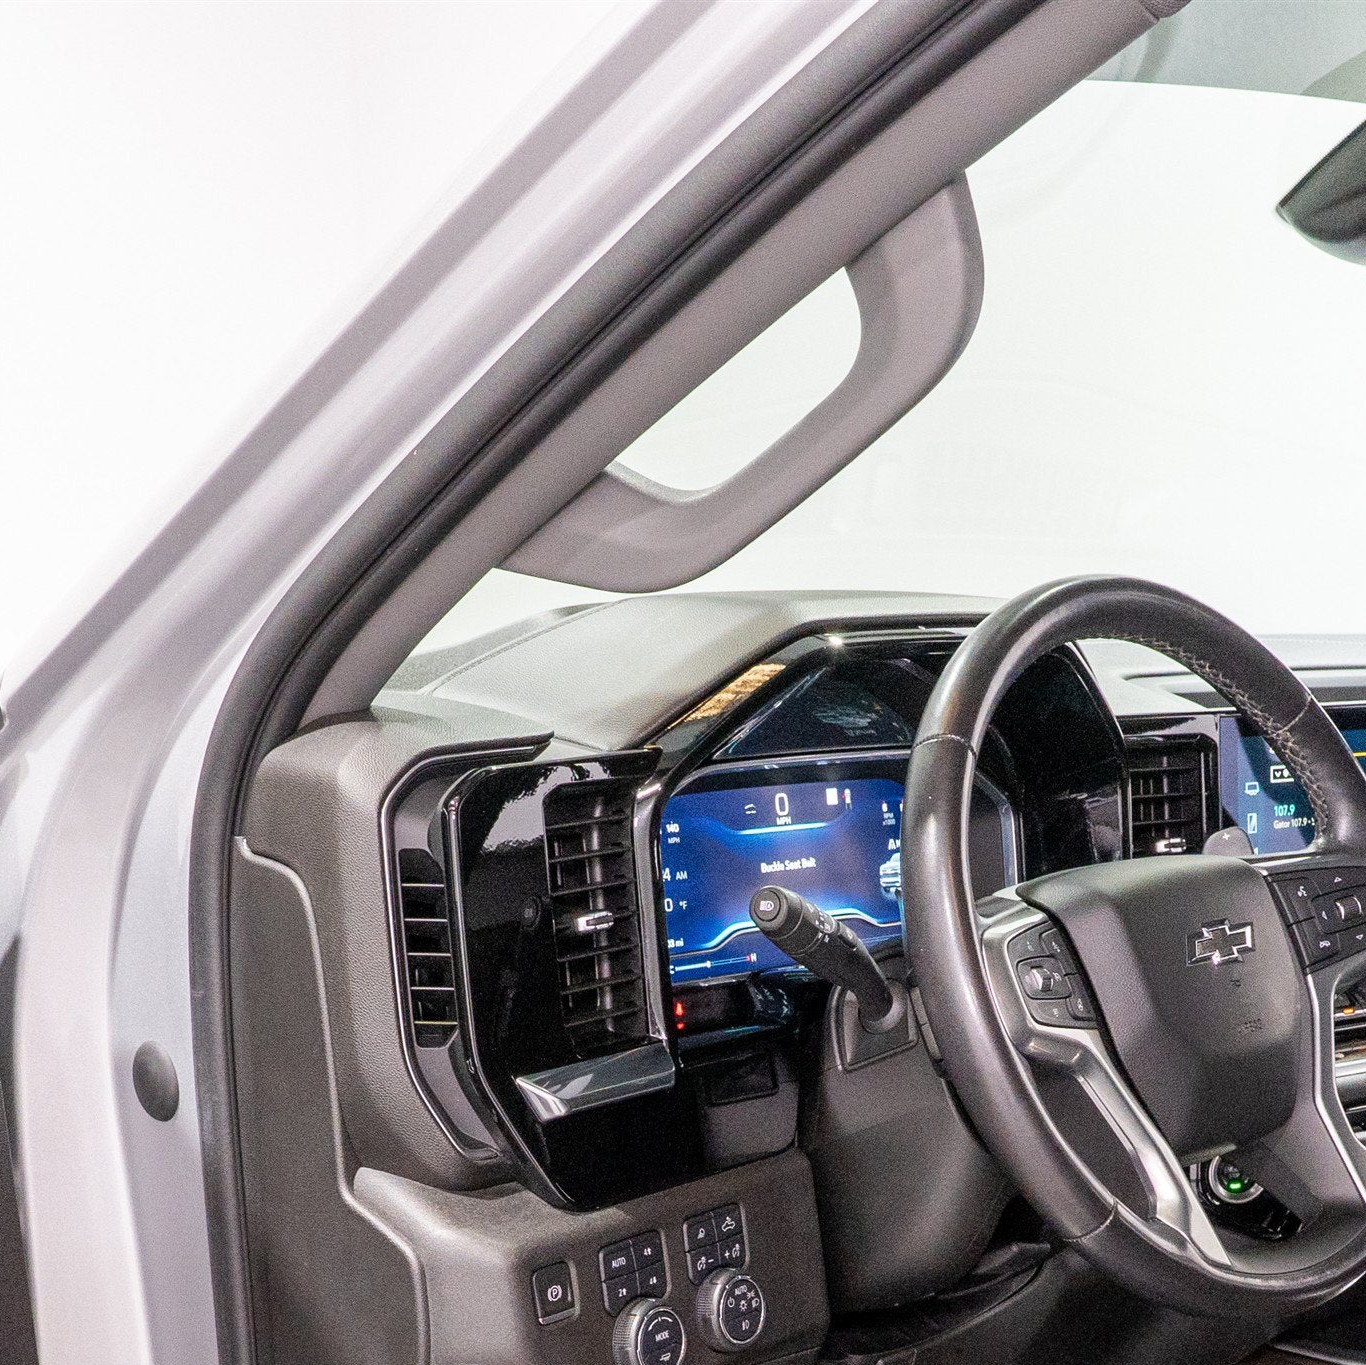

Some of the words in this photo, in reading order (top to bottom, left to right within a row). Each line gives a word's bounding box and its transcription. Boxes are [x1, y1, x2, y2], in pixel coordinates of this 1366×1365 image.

[775, 792, 789, 816] 0
[1274, 805, 1295, 816] 107.9
[776, 816, 792, 826] MPH
[1274, 819, 1291, 829] Gator
[1291, 817, 1307, 827] 107.9
[665, 823, 680, 833] 140
[760, 861, 785, 874] Buckle
[784, 859, 802, 871] Seat
[801, 856, 817, 869] Belt
[675, 870, 688, 880] AM
[675, 937, 684, 947] mi
[611, 1256, 627, 1269] AUTO
[734, 1284, 748, 1296] AUTO
[655, 1330, 670, 1342] MODE
